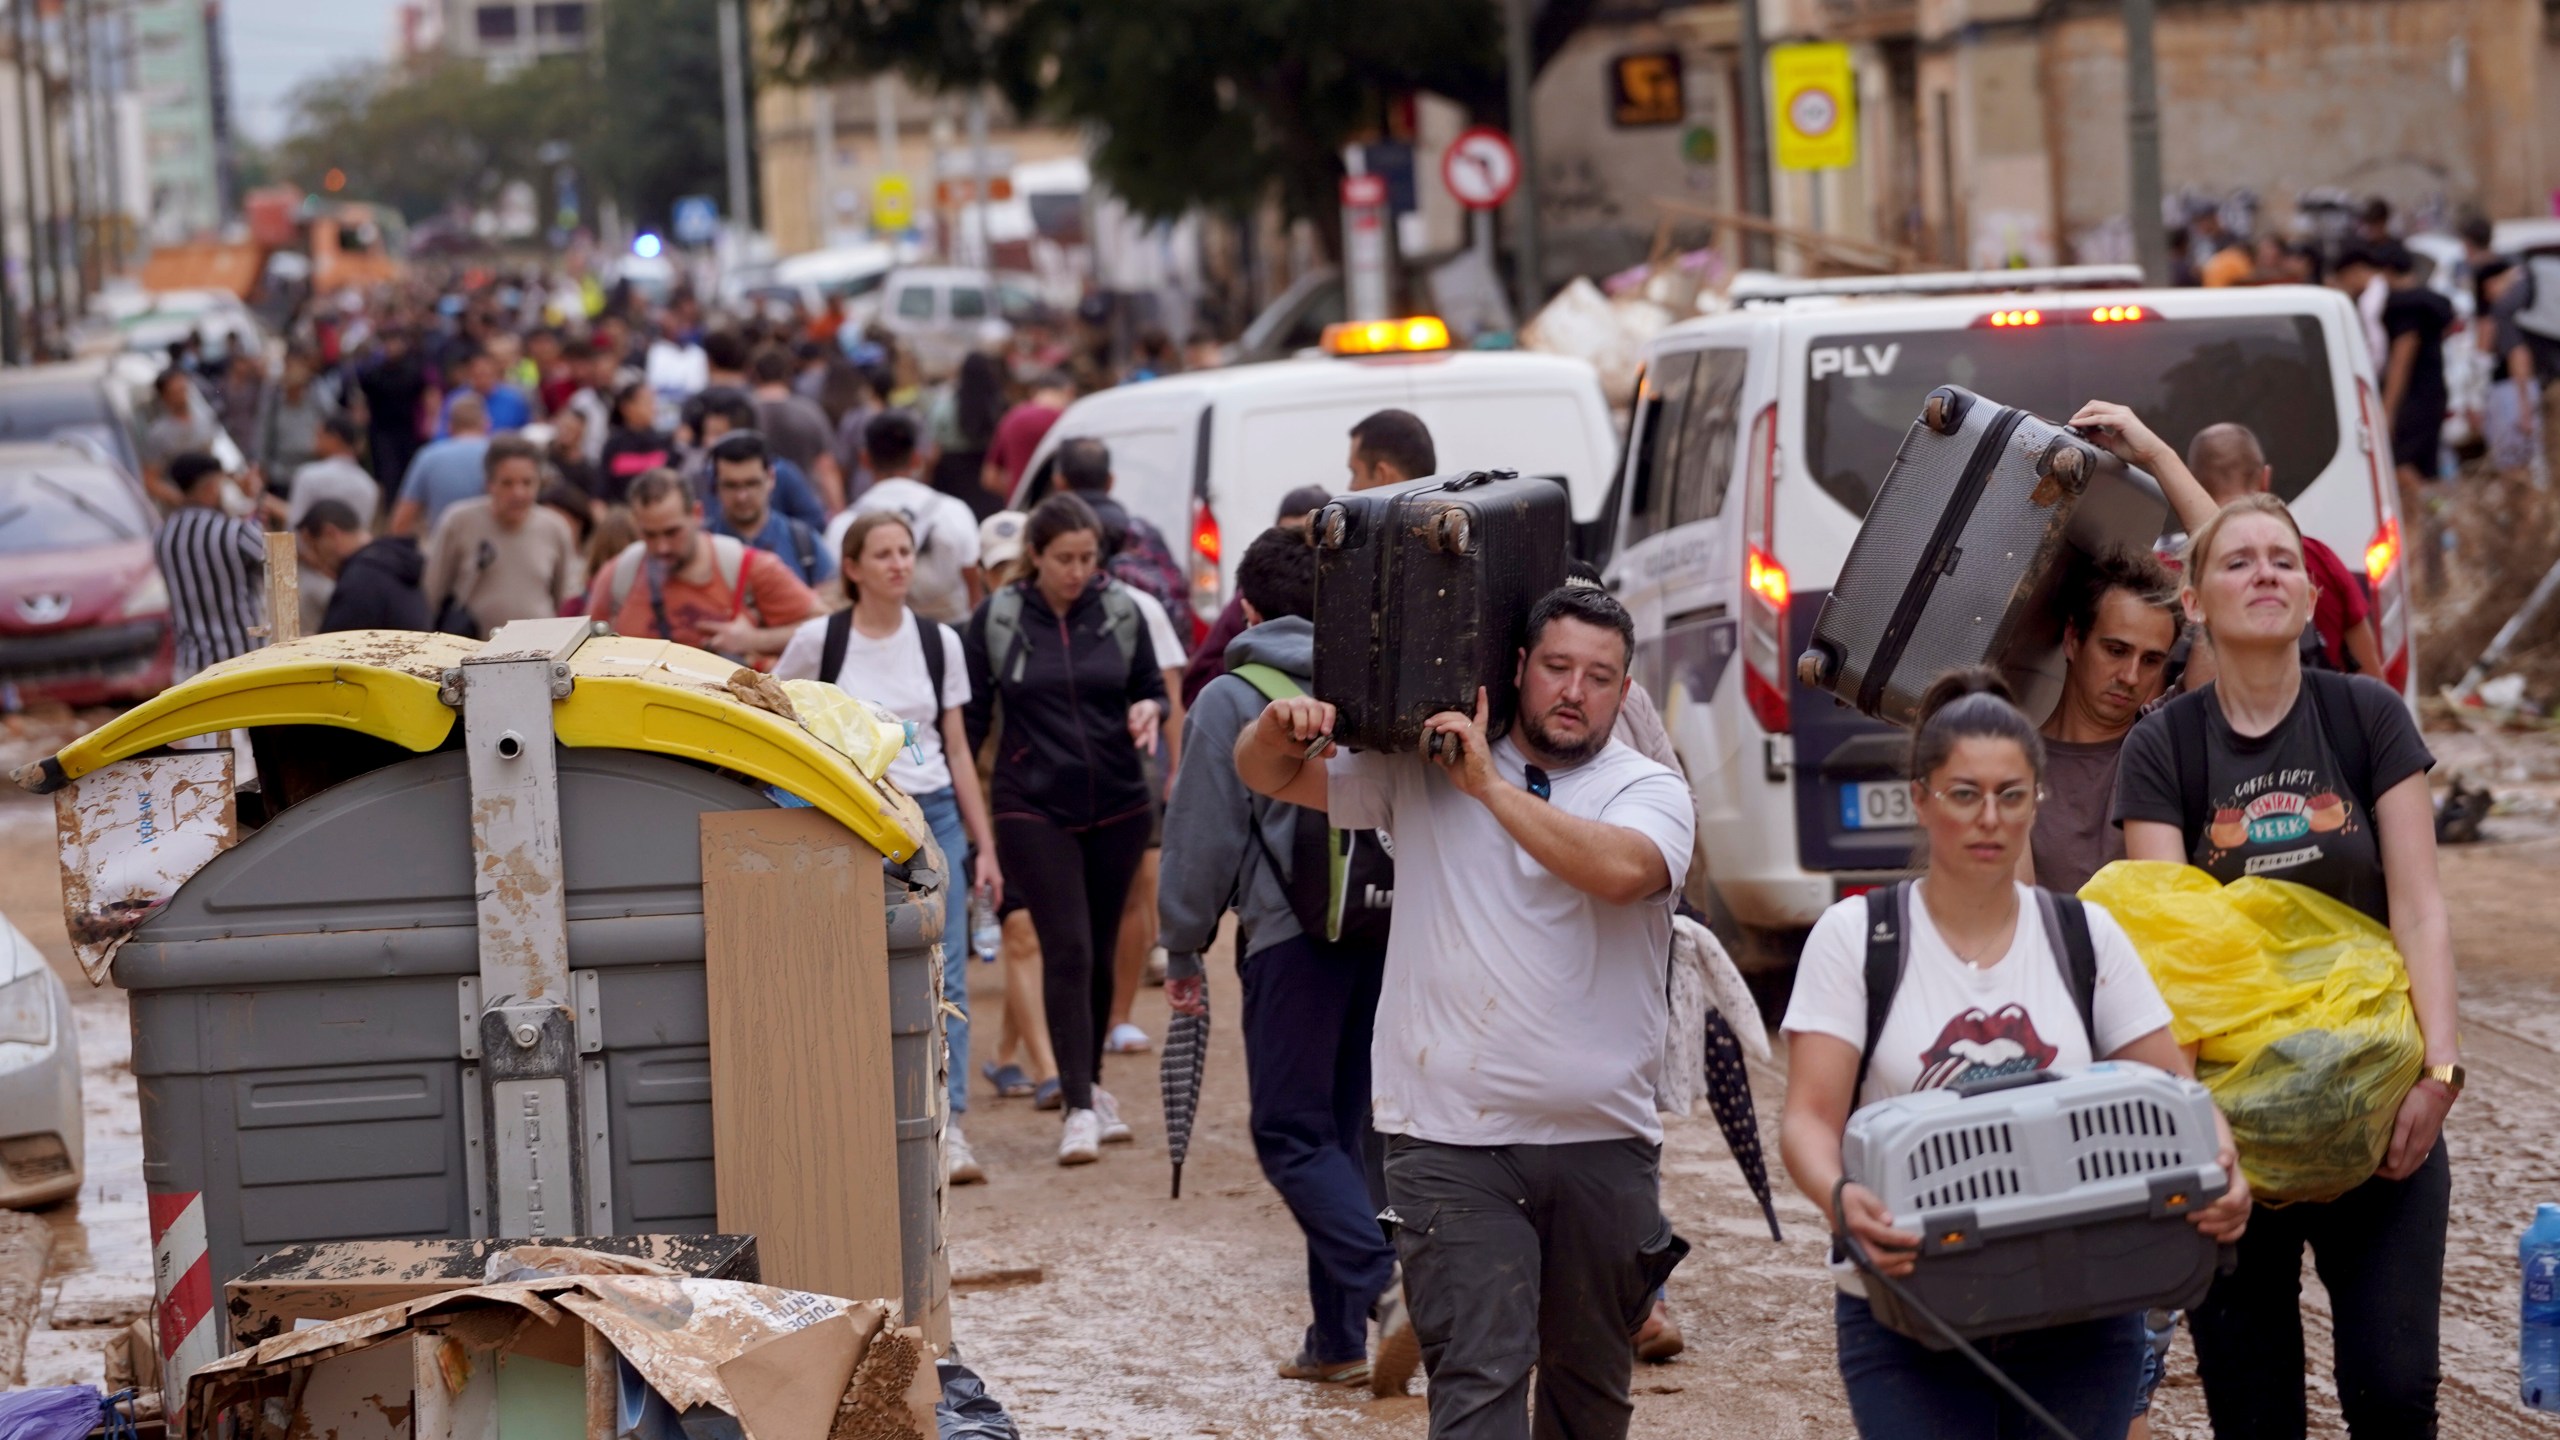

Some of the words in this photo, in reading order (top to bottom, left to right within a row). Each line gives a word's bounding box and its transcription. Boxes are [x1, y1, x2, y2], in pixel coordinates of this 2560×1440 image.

[1811, 343, 1900, 380] PLV
[2235, 771, 2275, 797] COFFEE
[2279, 768, 2316, 787] FIRST
[2254, 818, 2300, 839] PERK
